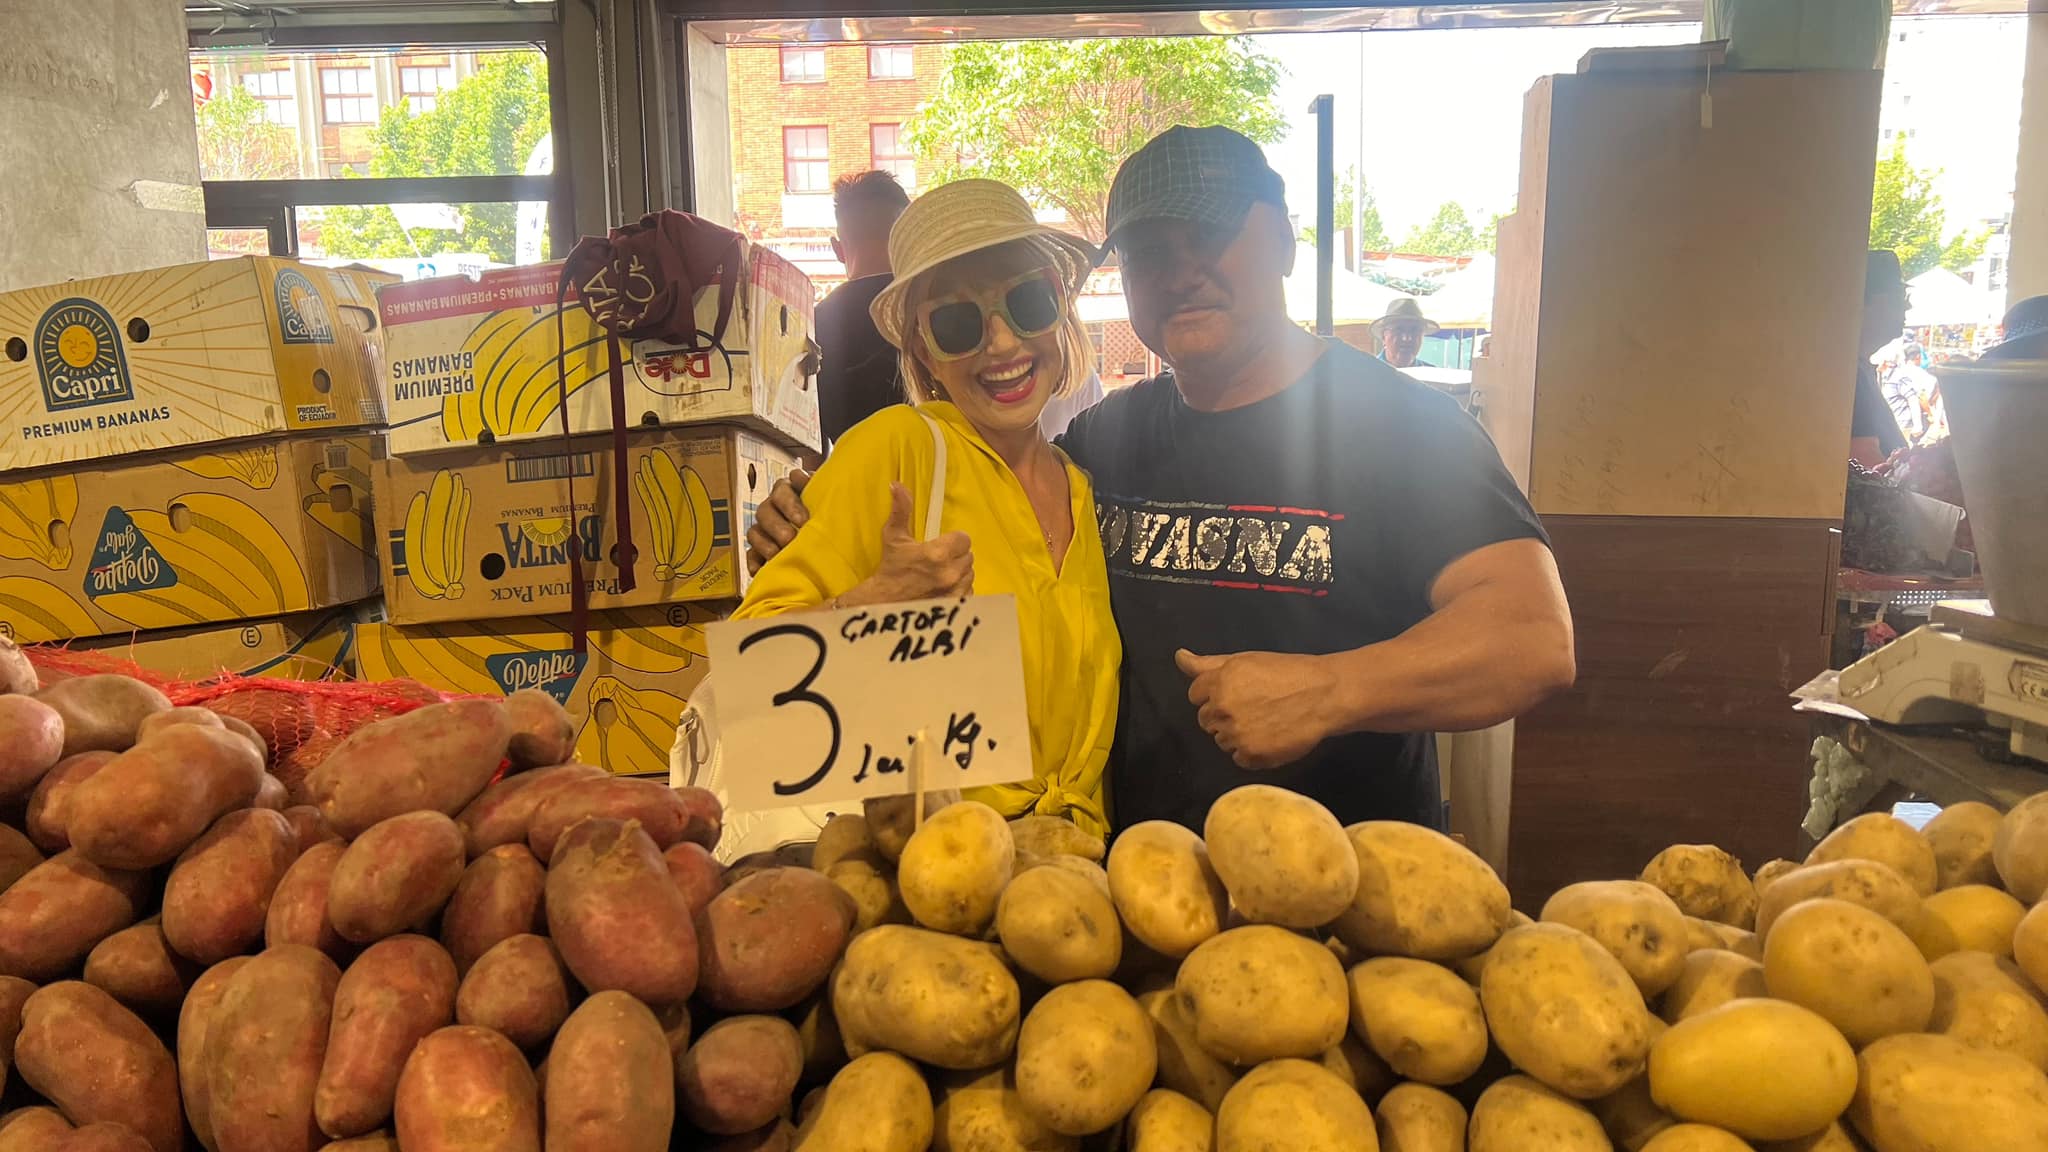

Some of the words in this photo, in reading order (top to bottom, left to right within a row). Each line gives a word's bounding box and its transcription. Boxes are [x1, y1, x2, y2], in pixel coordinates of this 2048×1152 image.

[439, 290, 493, 307] PREMIUM
[499, 282, 554, 299] BANANAS
[386, 298, 438, 315] BANANAS
[393, 351, 473, 378] BANANAS
[645, 353, 711, 383] Dole
[51, 366, 120, 401] Capri
[394, 373, 474, 401] PREMIUM
[297, 405, 327, 414] PRODUCT
[299, 414, 308, 422] OF
[23, 418, 94, 440] PREMIUM
[98, 406, 171, 429] BANANAS
[501, 506, 544, 517] BANANAS
[94, 546, 159, 591] Peppe
[491, 585, 534, 603] PACK
[538, 578, 621, 597] PREIUM
[503, 652, 577, 690] Peppe
[739, 623, 841, 796] 3
